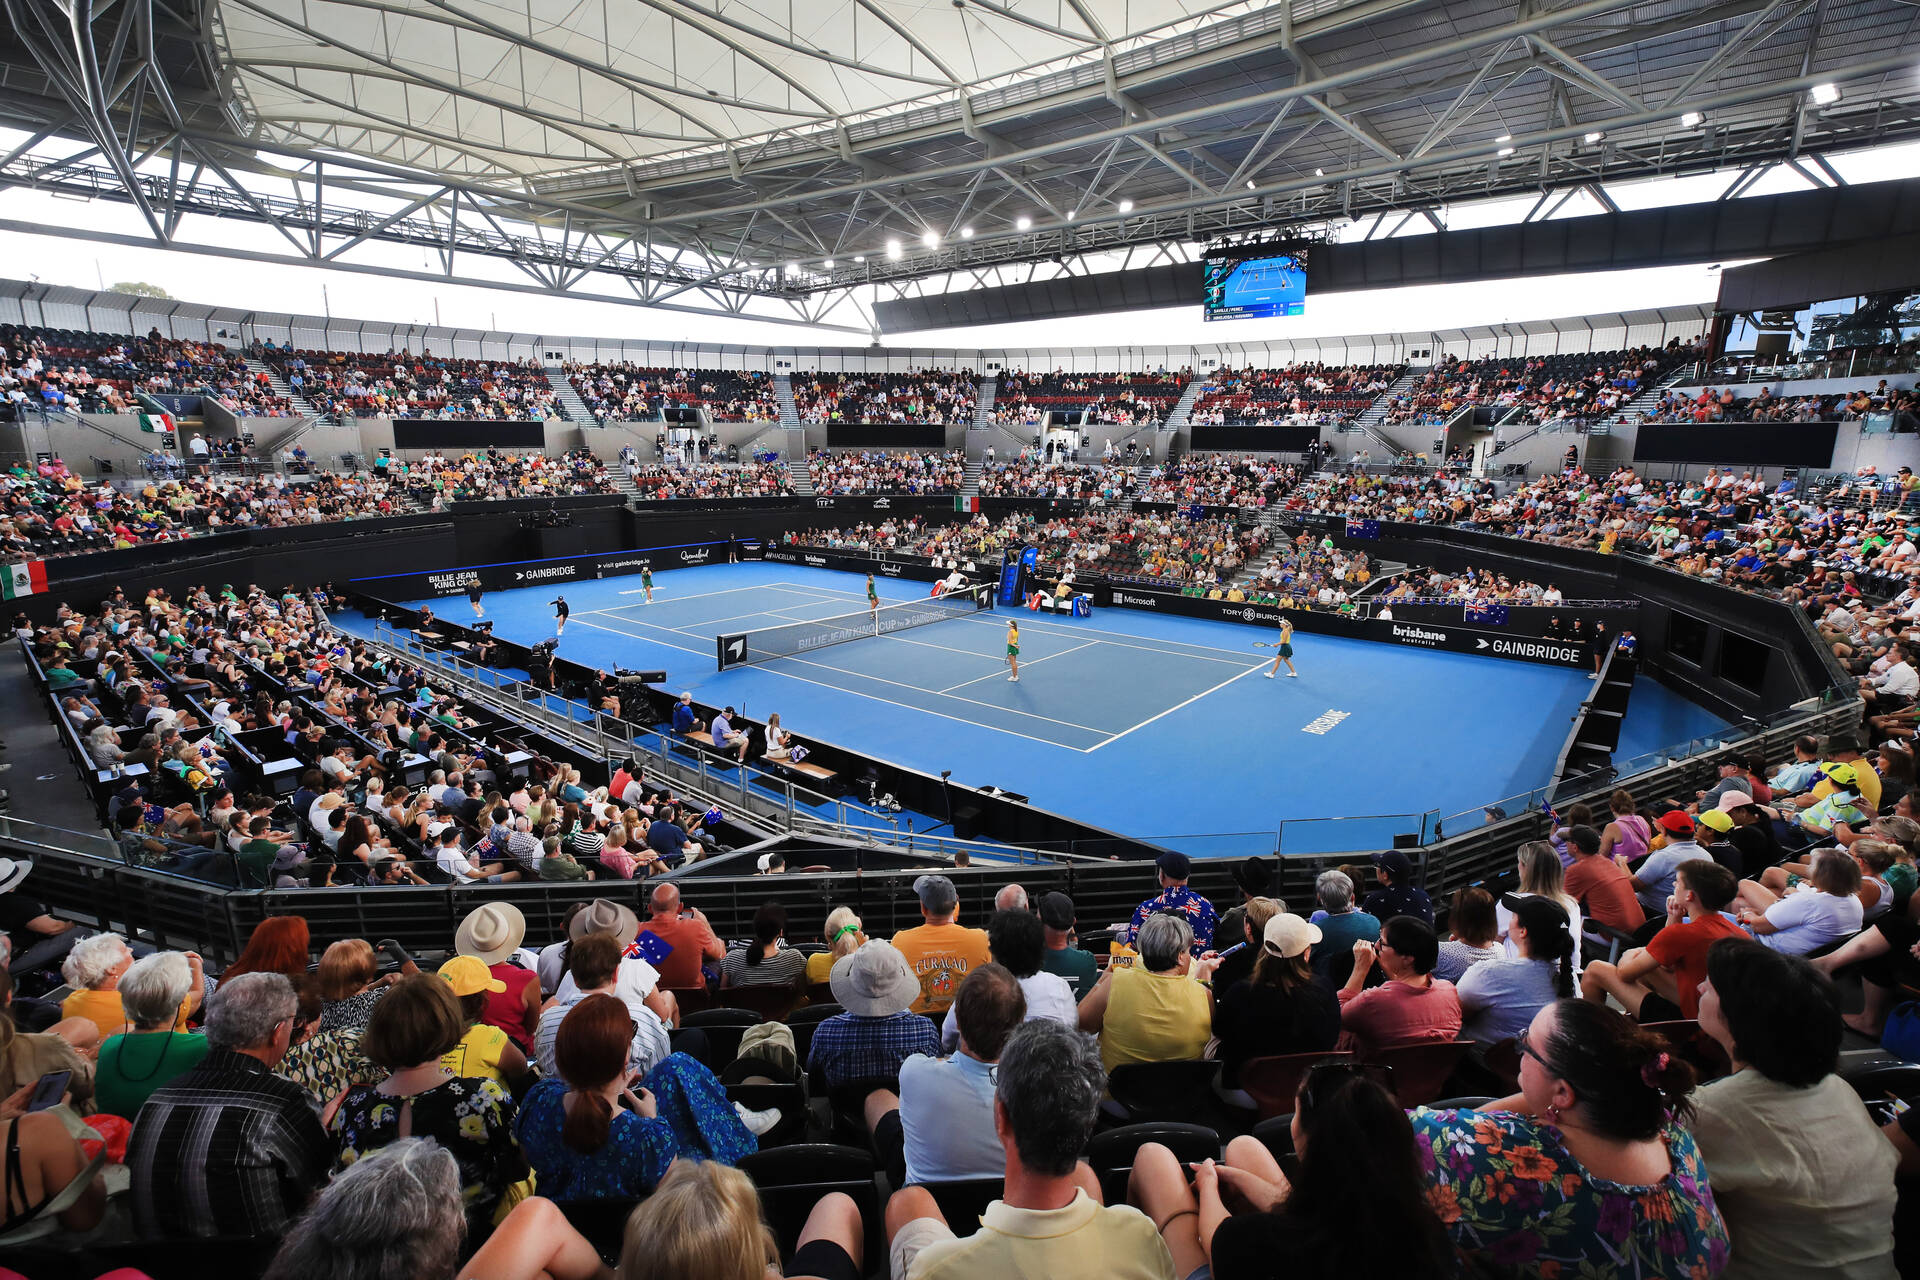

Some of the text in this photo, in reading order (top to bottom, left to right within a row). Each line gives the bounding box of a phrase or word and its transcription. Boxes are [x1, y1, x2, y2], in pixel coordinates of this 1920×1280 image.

[615, 558, 650, 568] gainbridge.io
[428, 571, 478, 583] BILLIE JEAN
[526, 565, 576, 580] GAINBRIDGE
[434, 580, 456, 589] KING
[1124, 595, 1156, 607] Microsoft
[1221, 608, 1285, 622] TORY BURCH
[798, 633, 827, 649] BILLIE
[828, 628, 851, 643] JEAN
[879, 619, 897, 631] CUP
[1393, 625, 1446, 642] brisbane
[1402, 637, 1436, 646] australia
[1492, 639, 1580, 663] GAINBRIDGE
